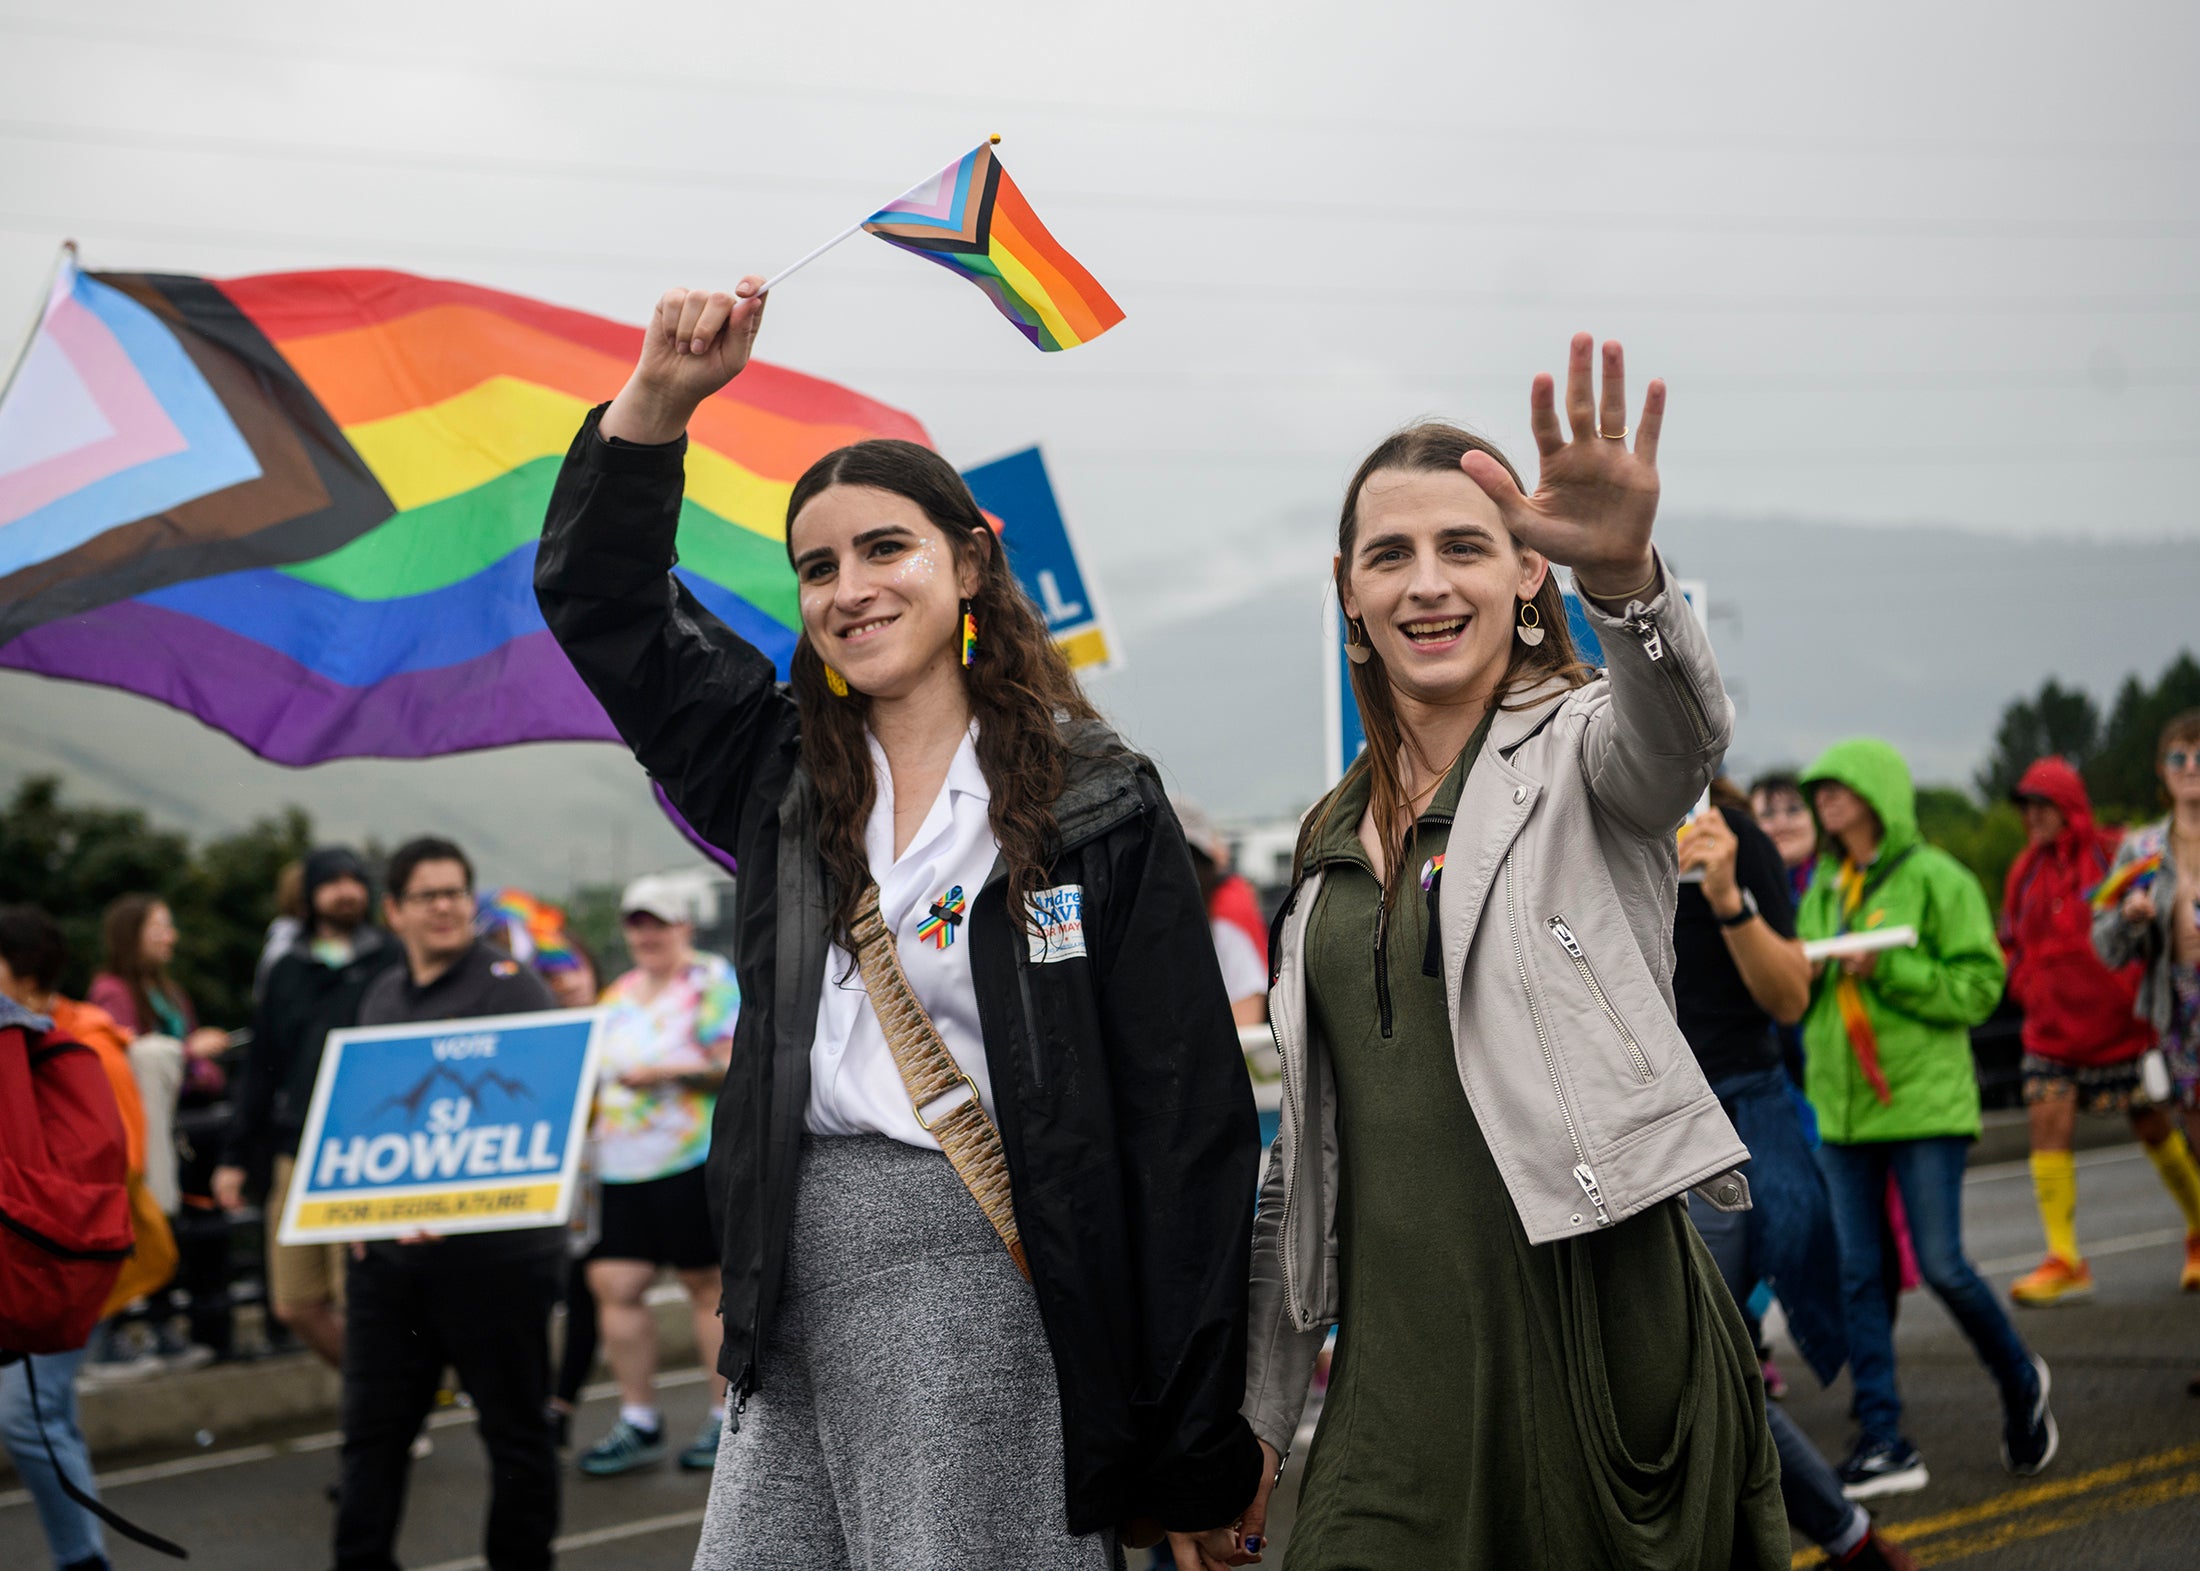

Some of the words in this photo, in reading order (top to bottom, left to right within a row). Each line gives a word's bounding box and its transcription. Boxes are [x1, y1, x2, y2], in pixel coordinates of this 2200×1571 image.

[1036, 890, 1083, 908] Andre
[1035, 904, 1083, 926] DAVI
[1058, 922, 1082, 935] MAY
[432, 1034, 498, 1061] VOTE
[427, 1096, 471, 1134] SJ
[317, 1121, 559, 1187] HOWELL
[325, 1204, 371, 1223] FOR
[378, 1191, 529, 1219] LEGISLATURE
